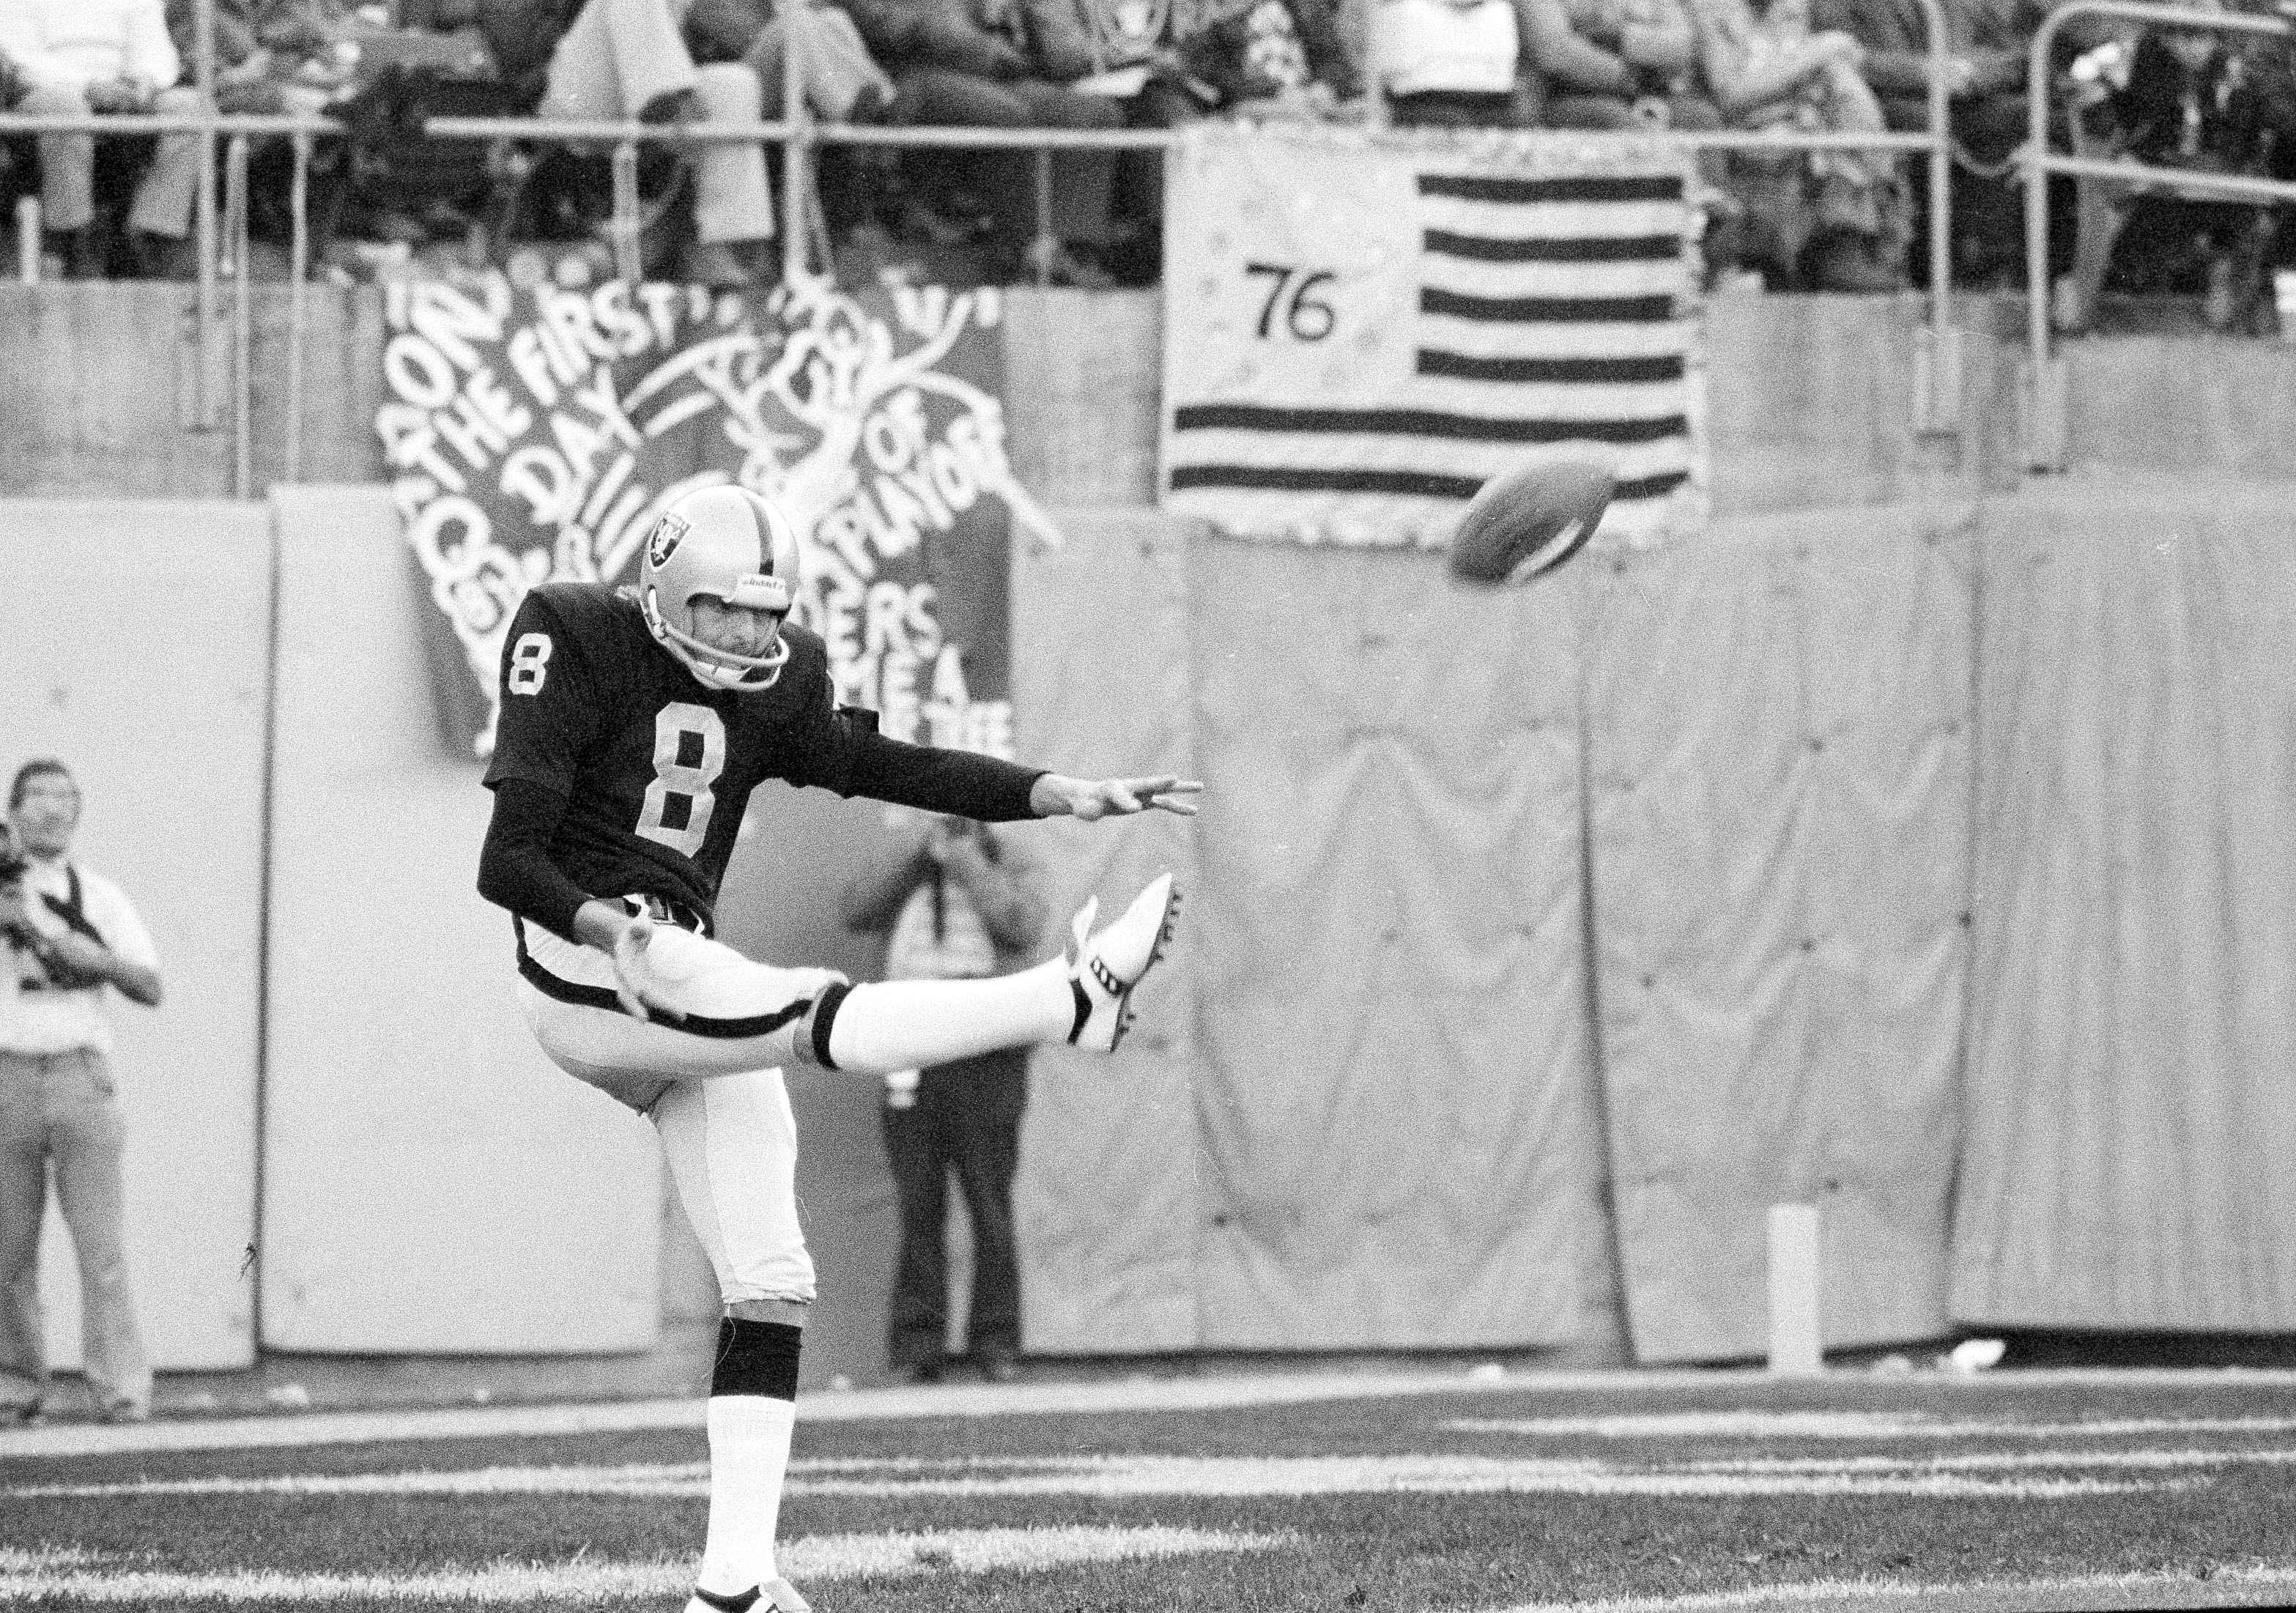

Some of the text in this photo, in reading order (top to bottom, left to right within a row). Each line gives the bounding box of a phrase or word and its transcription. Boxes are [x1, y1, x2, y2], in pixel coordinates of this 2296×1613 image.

[384, 265, 511, 409] ON
[1245, 262, 1336, 343] 76
[396, 278, 678, 492] THE FIRST
[500, 365, 926, 524] DAY OF
[509, 633, 553, 696] 8
[635, 701, 726, 859] 8
